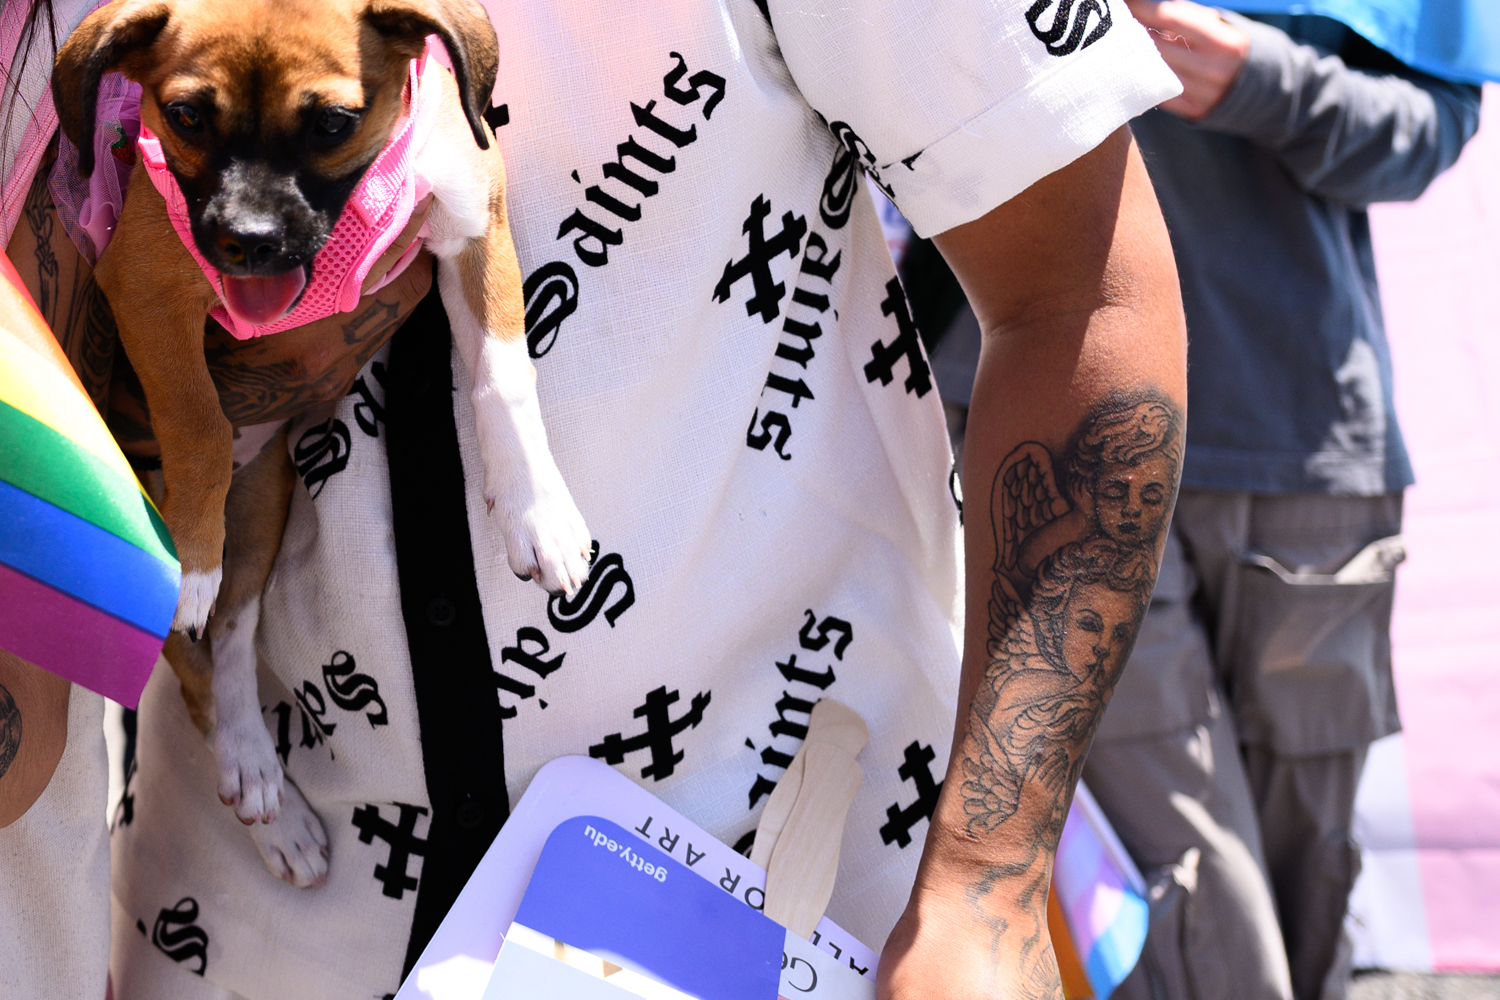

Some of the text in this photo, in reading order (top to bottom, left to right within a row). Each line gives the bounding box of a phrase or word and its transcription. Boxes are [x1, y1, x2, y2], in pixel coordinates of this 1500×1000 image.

[583, 824, 669, 884] getty.edu
[635, 815, 707, 867] ART
[719, 867, 766, 911] OR
